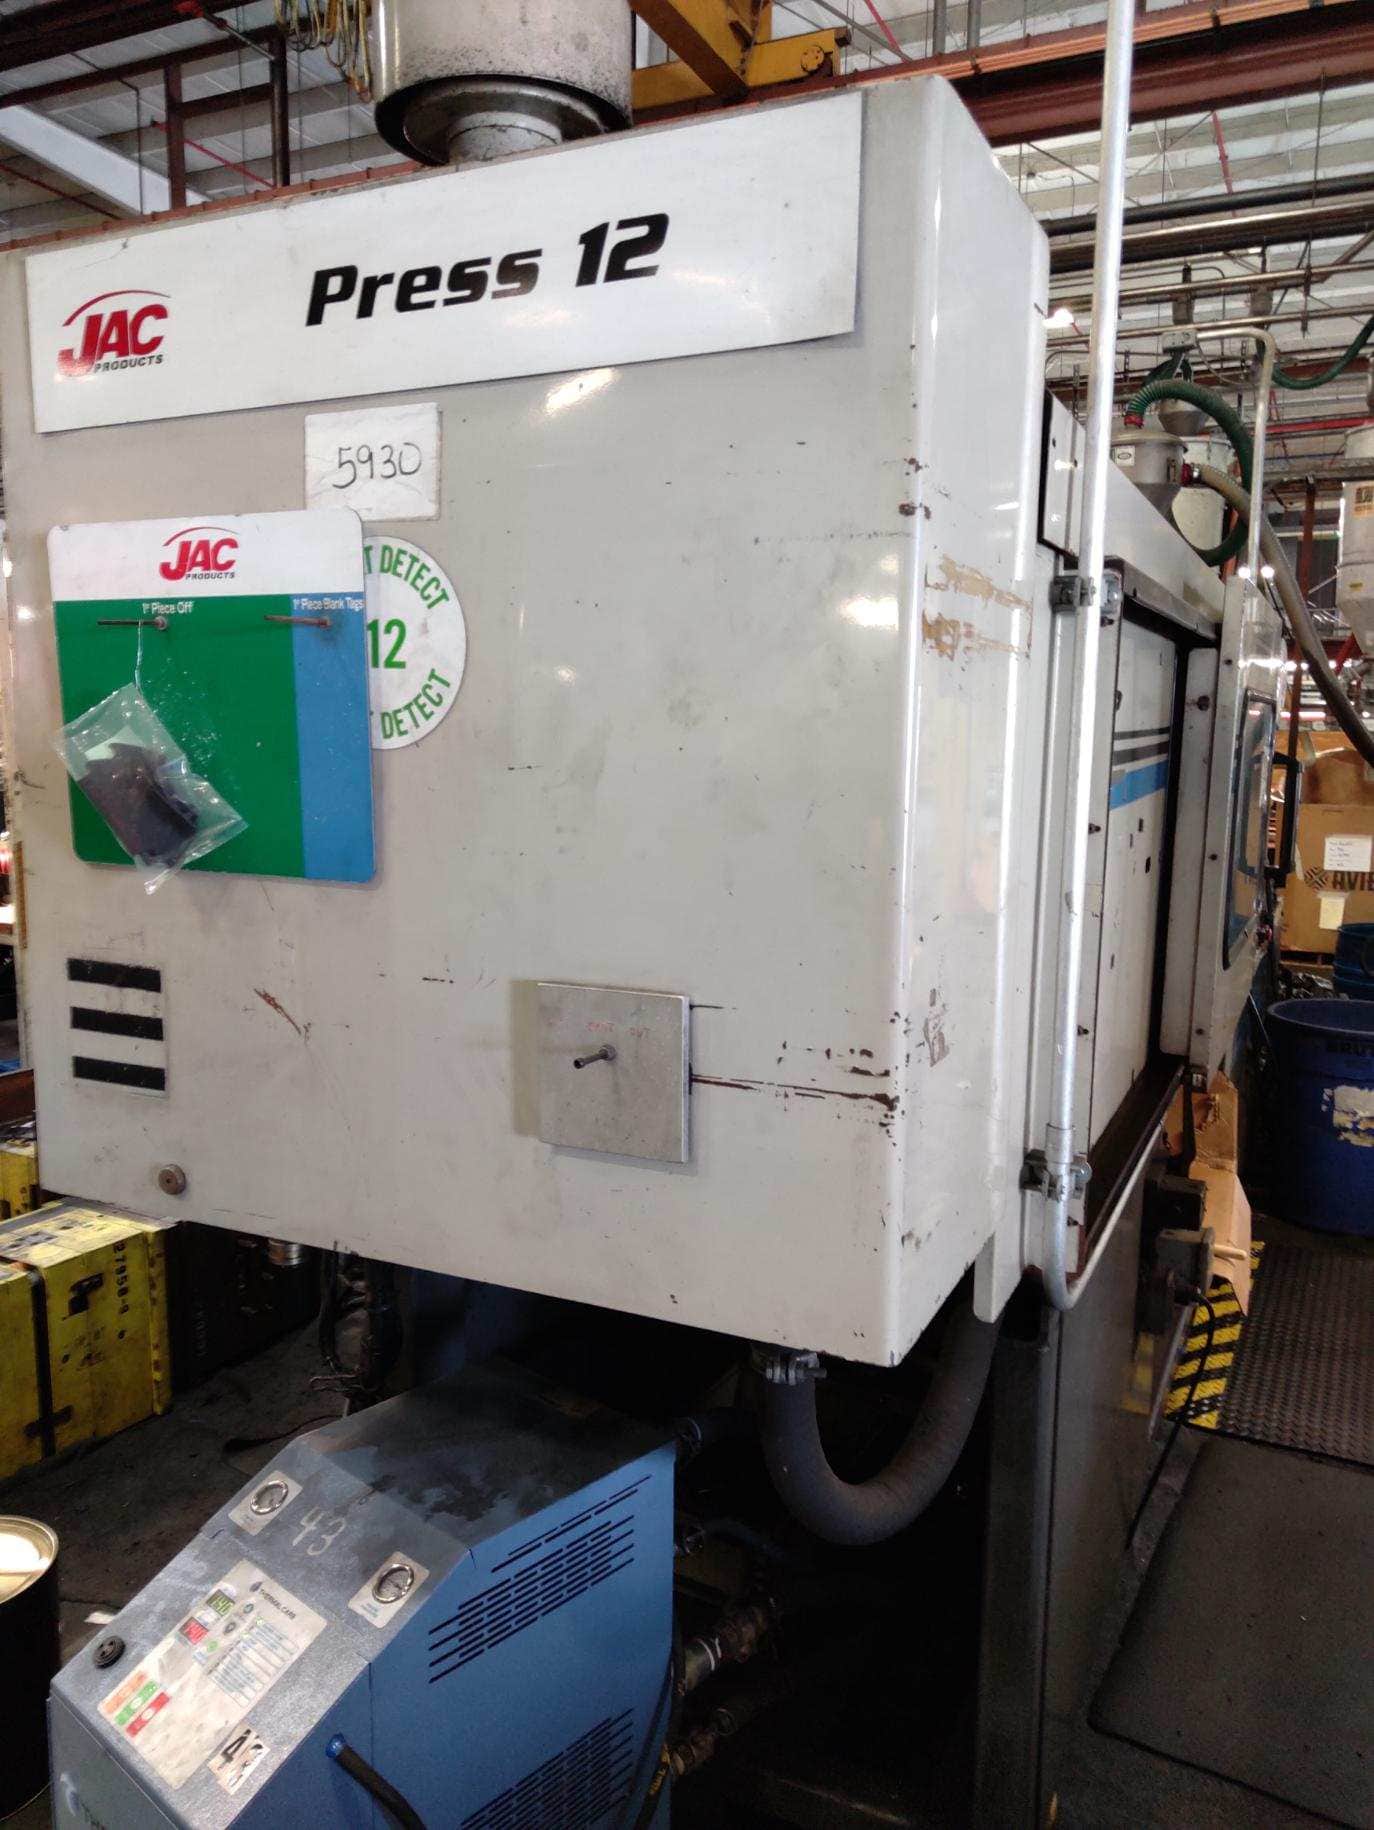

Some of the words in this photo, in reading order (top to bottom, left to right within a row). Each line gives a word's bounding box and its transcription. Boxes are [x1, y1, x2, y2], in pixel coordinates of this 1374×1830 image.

[305, 248, 543, 327] Press
[575, 212, 670, 287] 12
[58, 303, 168, 377] JAC
[94, 354, 164, 373] PRODUCTS
[332, 441, 422, 489] 5930
[160, 537, 239, 581] JAC
[185, 571, 236, 581] PRODUCTS
[380, 543, 450, 611] DETECT
[151, 601, 176, 615] Piece
[177, 600, 194, 614] Off
[366, 618, 407, 669] 12
[380, 668, 451, 740] DETECT
[292, 1506, 347, 1556] 43
